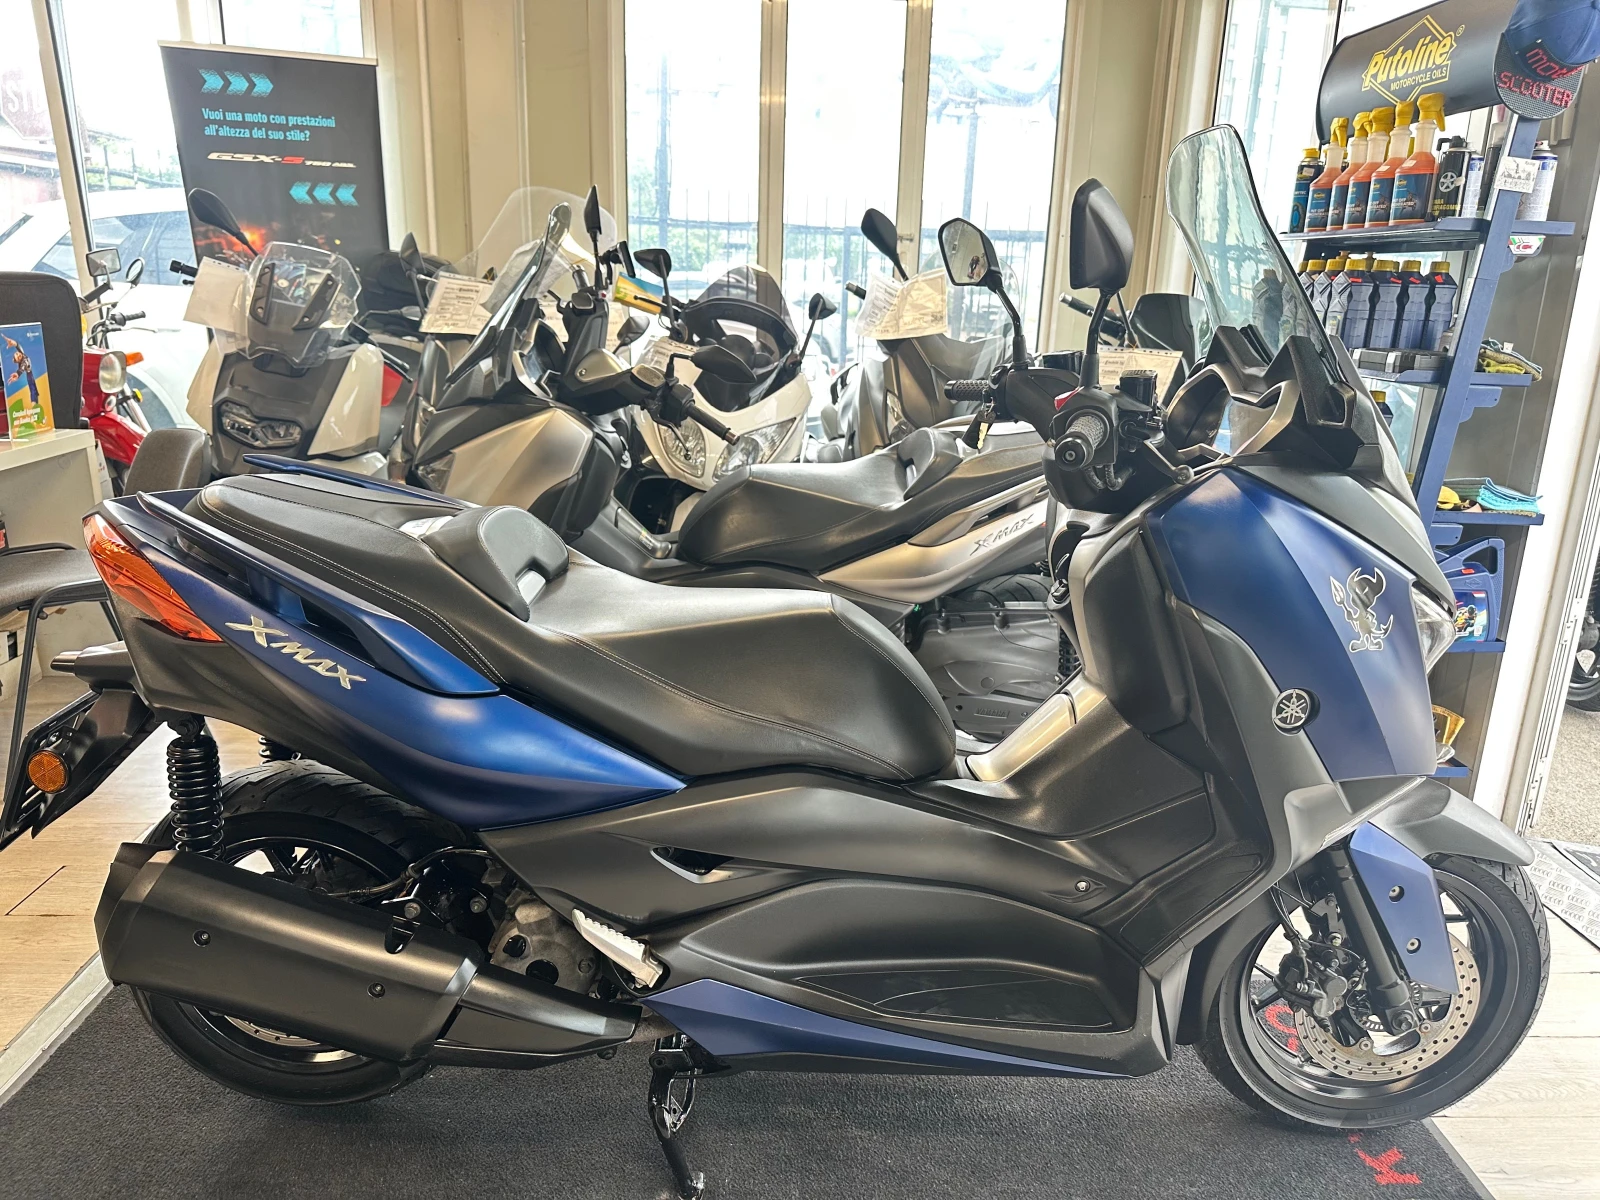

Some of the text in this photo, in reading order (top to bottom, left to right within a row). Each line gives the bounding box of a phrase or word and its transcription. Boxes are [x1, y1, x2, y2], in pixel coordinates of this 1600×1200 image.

[1365, 35, 1452, 87] Putoline
[1391, 66, 1447, 91] MOTORCYCLE OILS
[202, 108, 336, 128] Vuoi una moto con prestazioni
[204, 124, 310, 141] all'altezza del suo stile?
